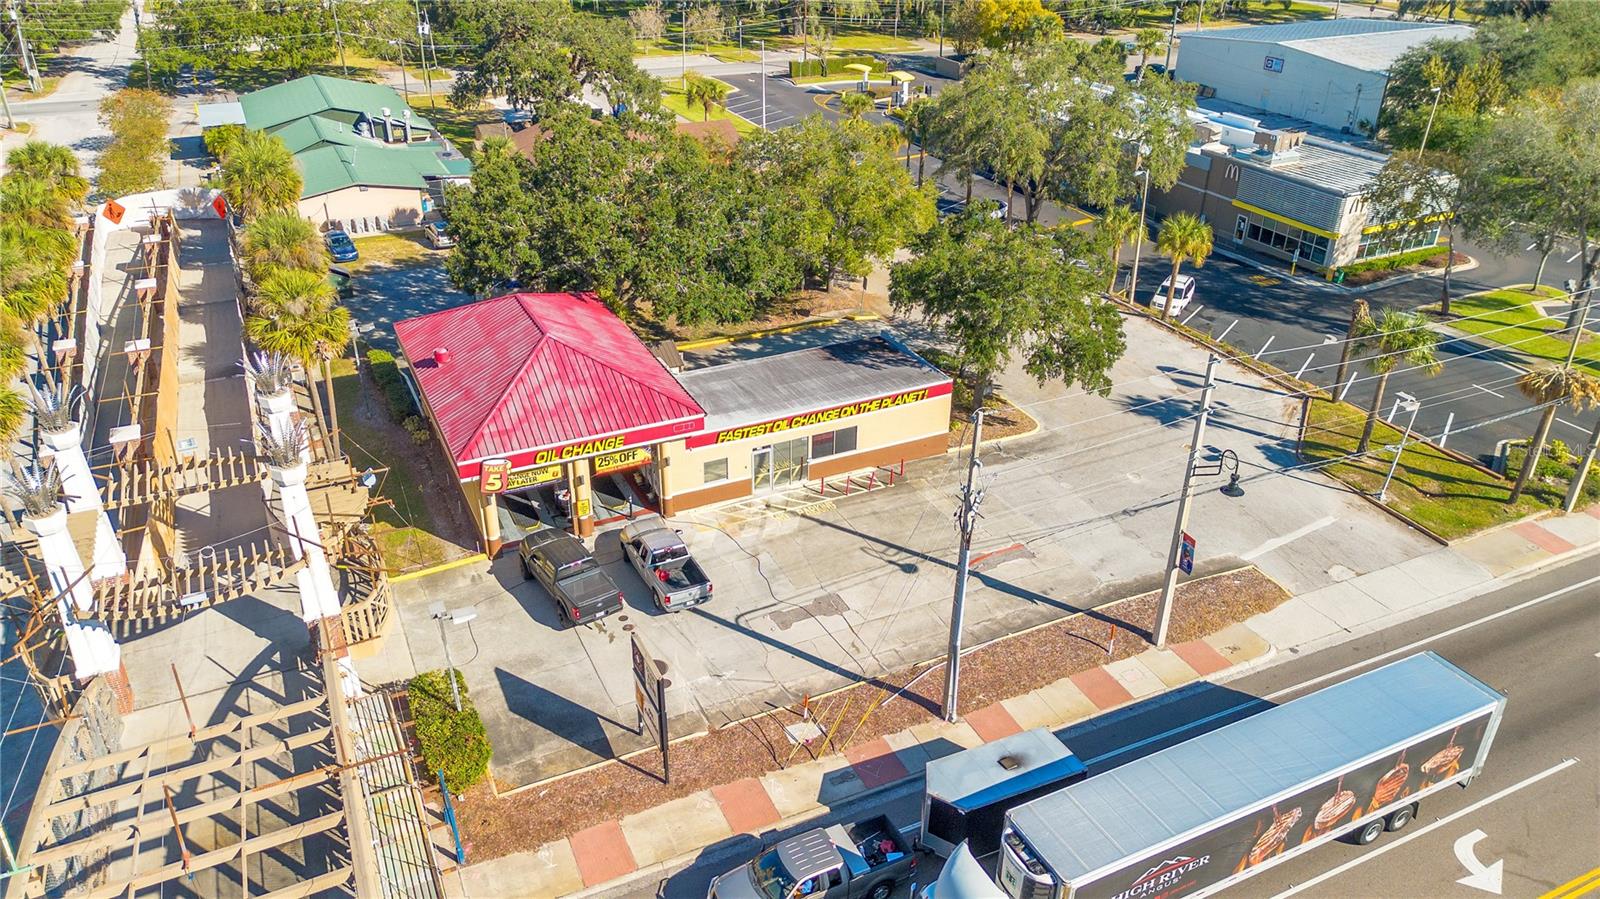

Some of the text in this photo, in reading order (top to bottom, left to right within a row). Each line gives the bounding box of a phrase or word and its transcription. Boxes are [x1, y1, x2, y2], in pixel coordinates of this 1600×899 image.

[718, 389, 929, 444] FASTEST OIL CHANGE ON THE PLANET!
[535, 436, 625, 464] OIL CHANGE
[598, 450, 638, 467] 25% OFF
[484, 464, 505, 473] TAKE
[531, 467, 548, 476] NOW
[485, 474, 503, 491] 5
[507, 477, 538, 486] AY LATER
[1159, 855, 1211, 884] RIVER
[1140, 877, 1180, 898] ANGUS
